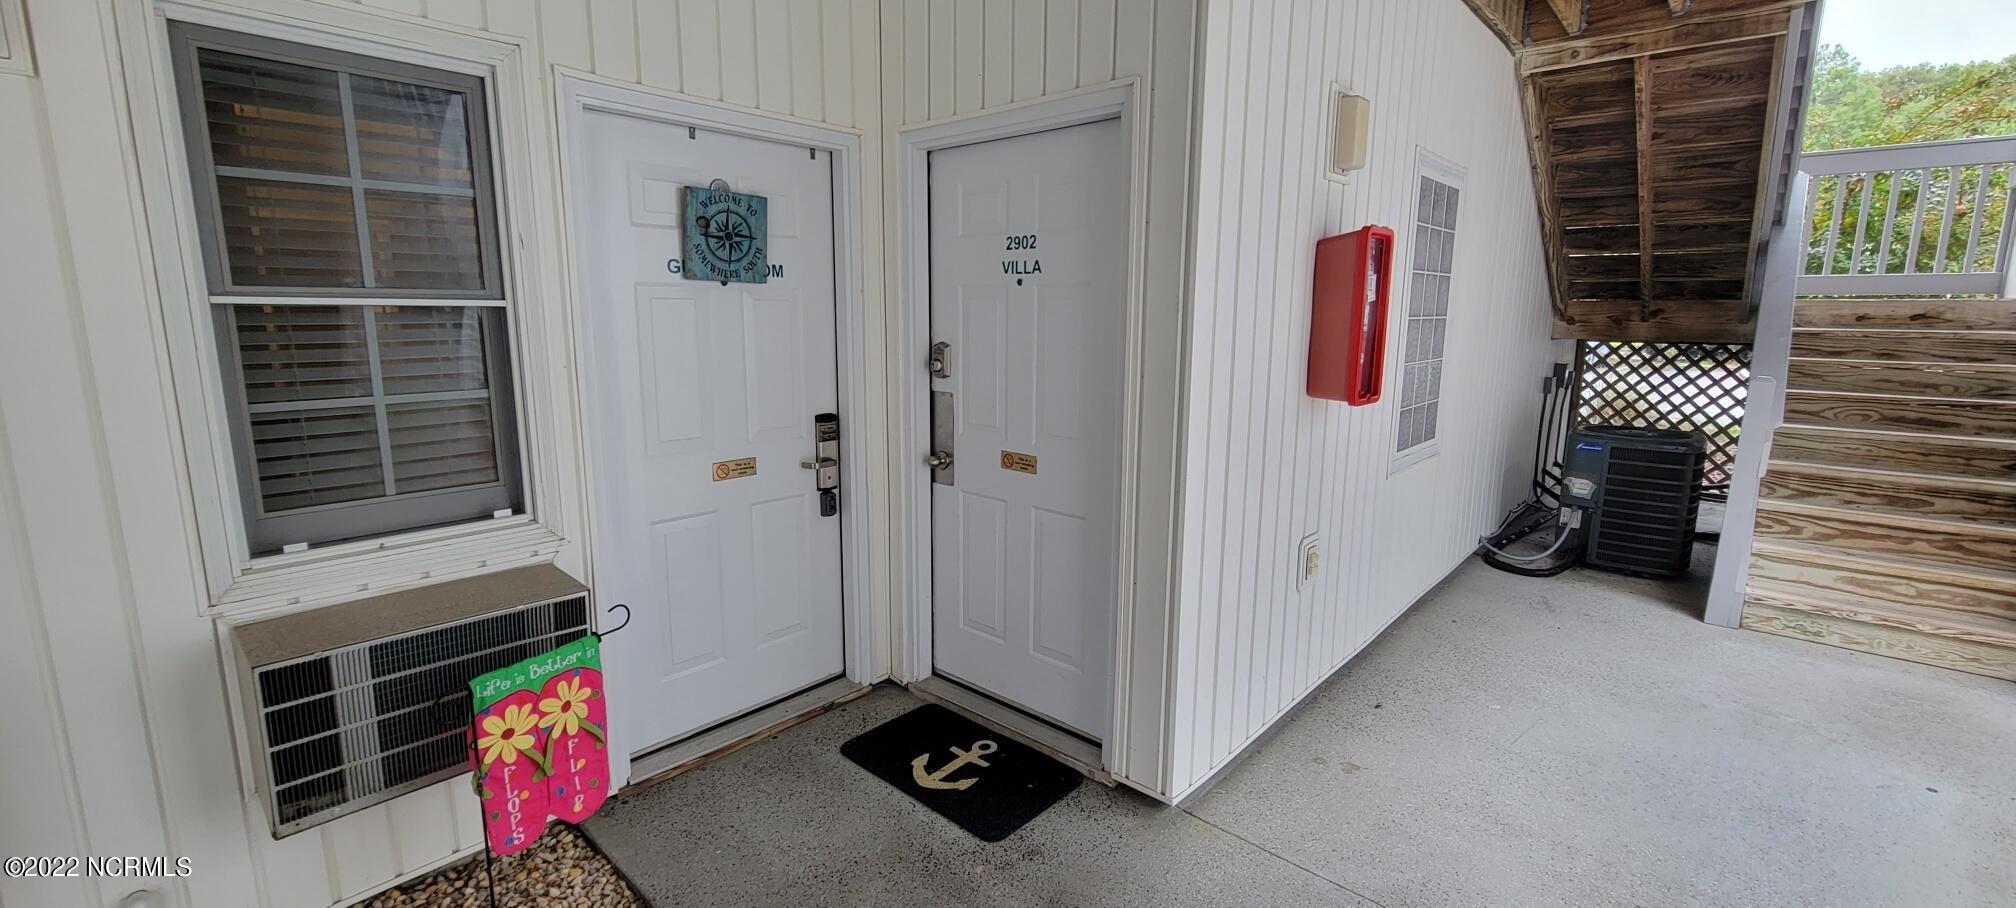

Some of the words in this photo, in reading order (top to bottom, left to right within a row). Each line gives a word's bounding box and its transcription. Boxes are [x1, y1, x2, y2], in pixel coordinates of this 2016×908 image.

[699, 193, 744, 210] WELCOME
[746, 204, 758, 217] TO
[693, 242, 741, 279] SOMEWHERE
[744, 247, 763, 274] SOUTH
[1006, 234, 1037, 250] 2902
[1002, 260, 1042, 275] VILLA
[476, 678, 512, 698] Life
[515, 672, 525, 685] is
[529, 650, 582, 680] Better
[585, 646, 596, 659] in
[567, 738, 585, 814] FLIP
[503, 765, 525, 845] FLOPS
